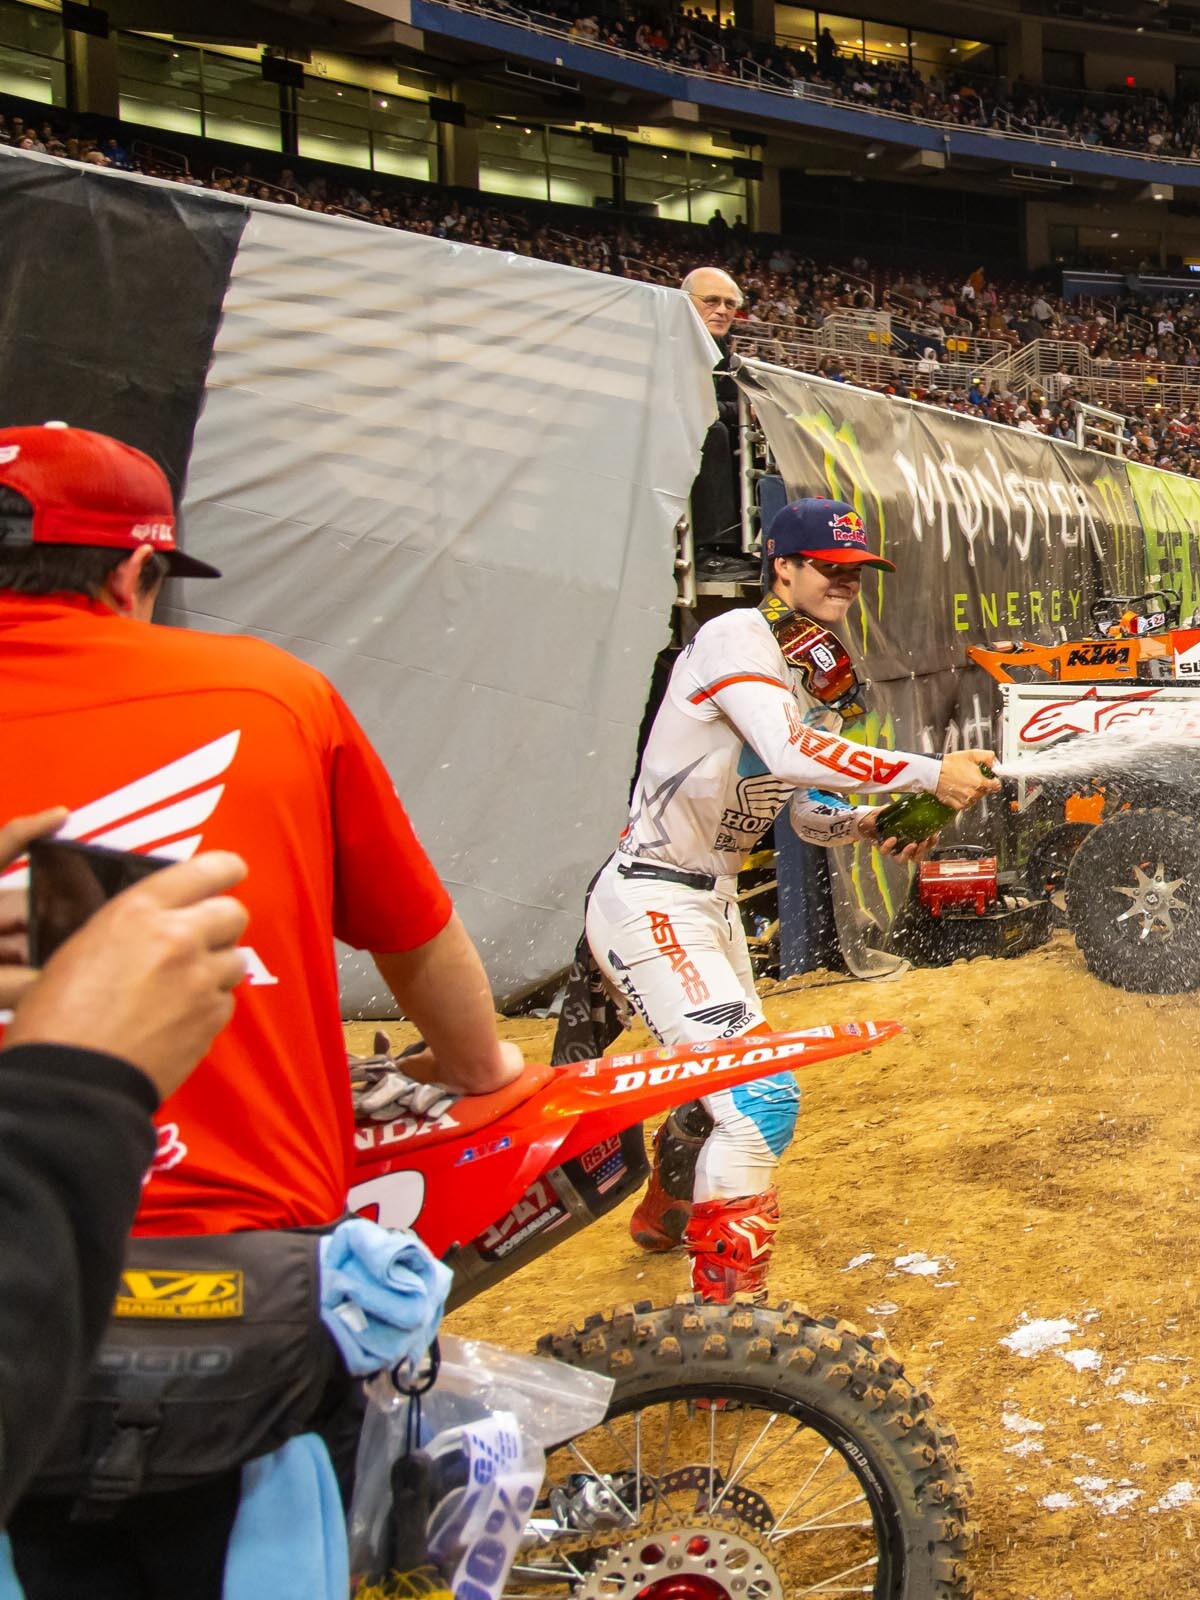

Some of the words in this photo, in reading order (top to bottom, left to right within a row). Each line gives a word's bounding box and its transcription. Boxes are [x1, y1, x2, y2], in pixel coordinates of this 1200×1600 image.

[893, 441, 1104, 567] MONSTER
[954, 591, 1081, 631] ENERGY
[812, 646, 835, 670] 100%
[1067, 643, 1129, 667] KTM
[646, 910, 710, 1006] ASTARS
[610, 1042, 806, 1095] DUNLOP
